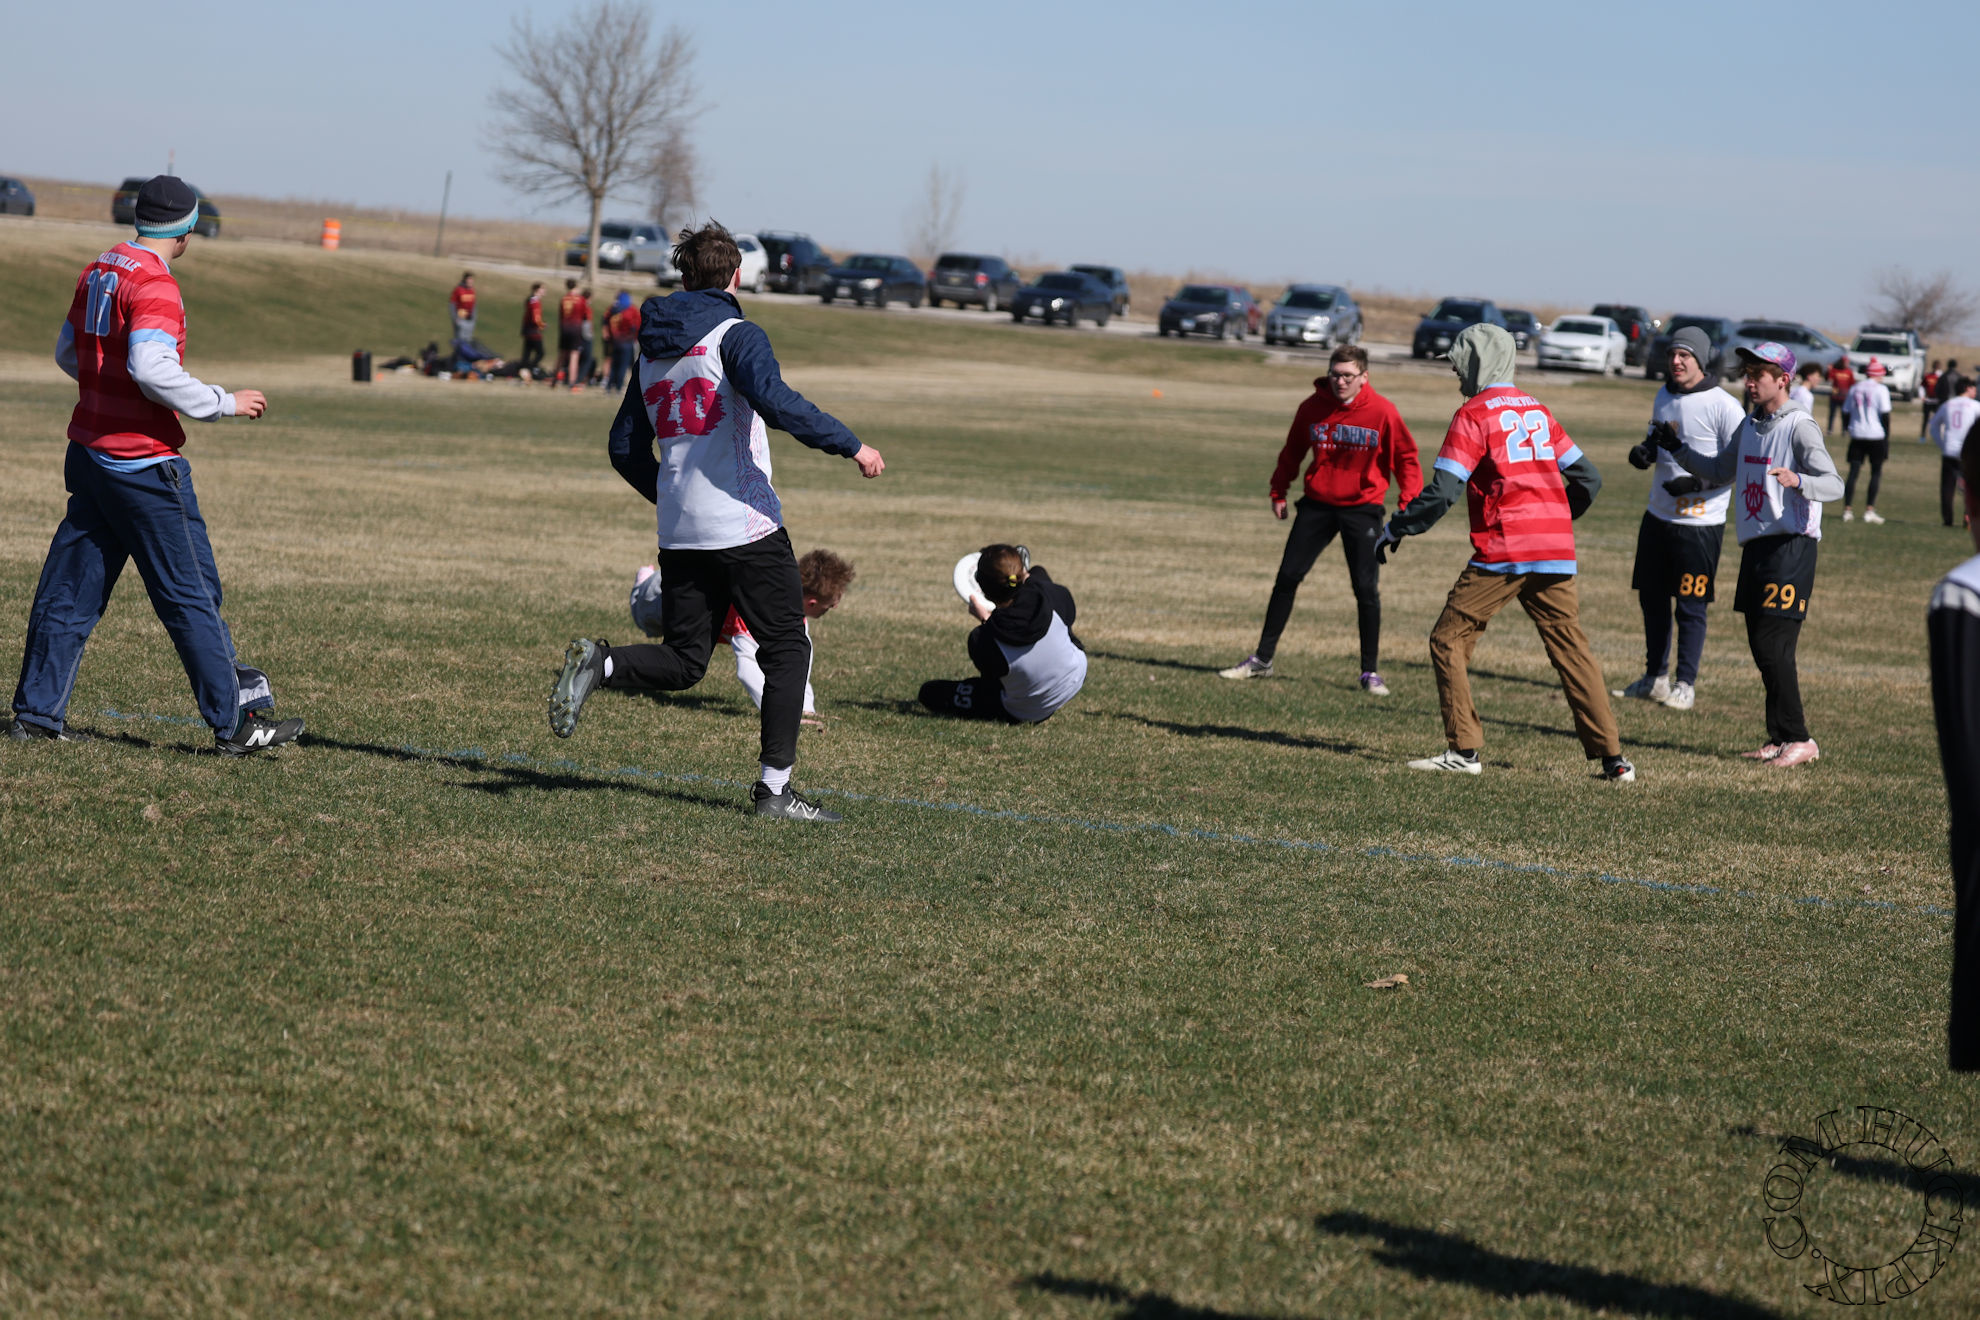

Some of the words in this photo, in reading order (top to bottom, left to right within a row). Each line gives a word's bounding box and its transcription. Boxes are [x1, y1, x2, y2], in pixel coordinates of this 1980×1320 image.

[643, 377, 726, 439] 20
[1498, 409, 1556, 464] 22
[1674, 496, 1707, 516] 88
[1679, 572, 1709, 597] 88
[1762, 582, 1796, 610] 29
